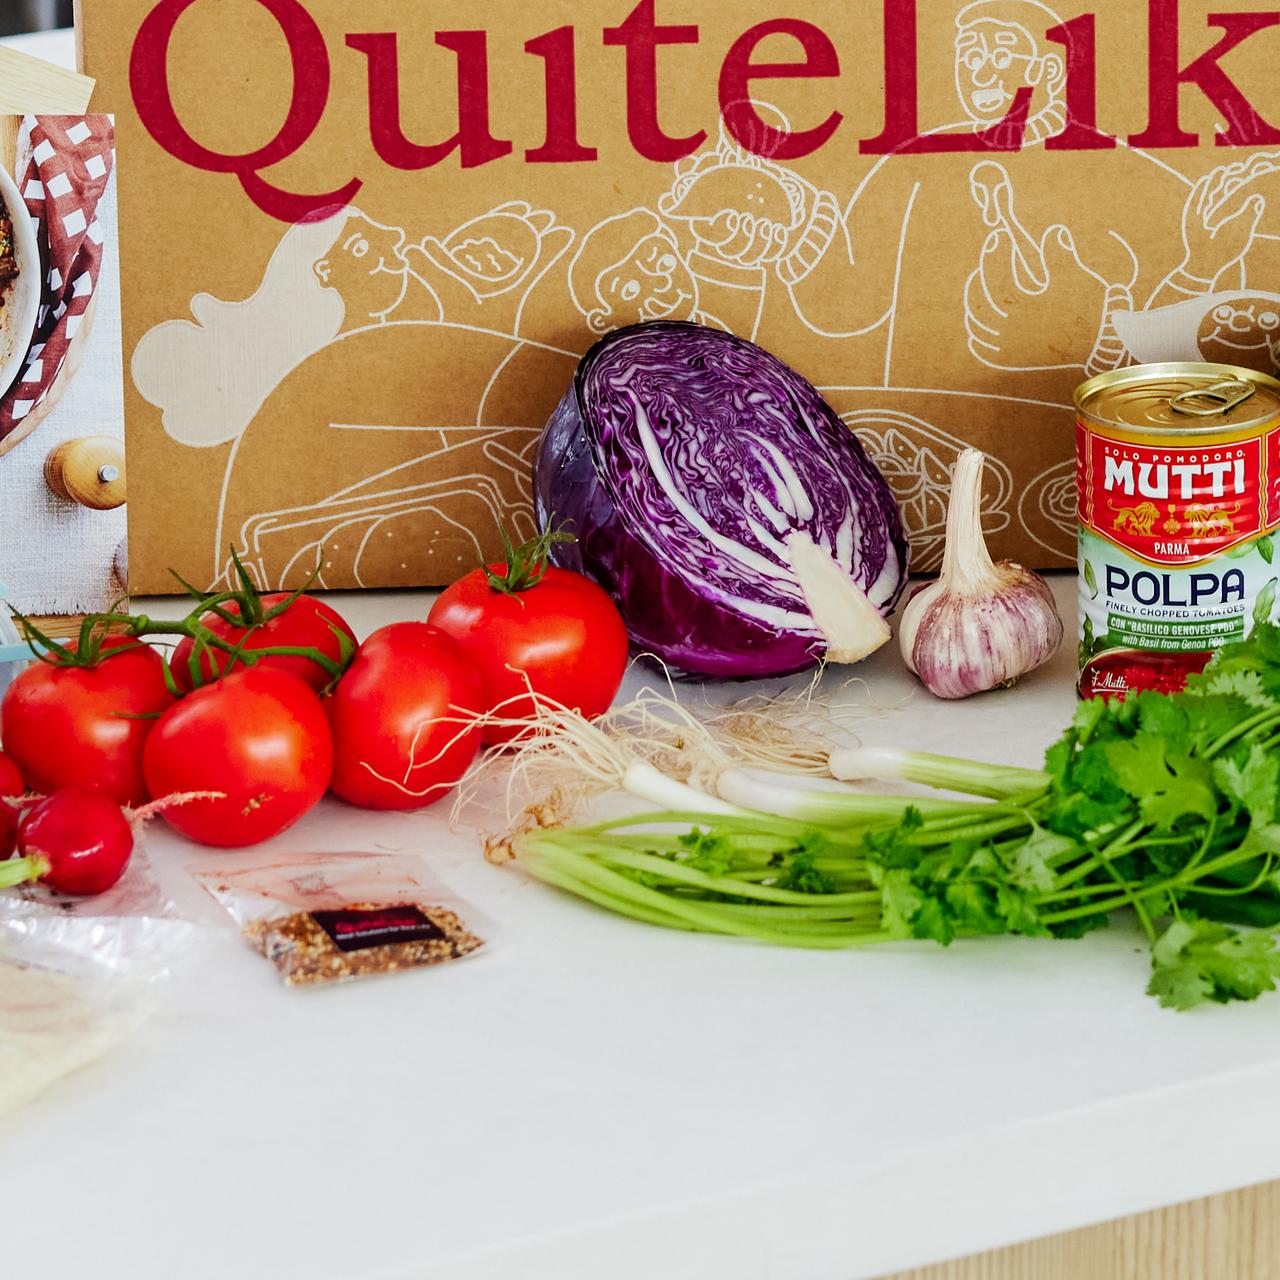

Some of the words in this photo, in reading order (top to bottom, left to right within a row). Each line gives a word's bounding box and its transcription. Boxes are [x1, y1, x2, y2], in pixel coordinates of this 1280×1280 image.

[1105, 446, 1139, 461] SOLO
[1104, 456, 1246, 500] MUTTI
[1154, 542, 1190, 555] PARMA
[1105, 564, 1245, 607] POLPA
[1105, 600, 1137, 614] FINELY
[1140, 607, 1190, 618] CHOPPED
[1192, 604, 1245, 618] TOMATOES
[1110, 617, 1126, 628] CON
[1172, 623, 1216, 635] GENOVESE
[1122, 634, 1138, 646] with
[1139, 636, 1158, 648] Basil
[1160, 638, 1180, 648] from
[1181, 638, 1207, 649] Genoa
